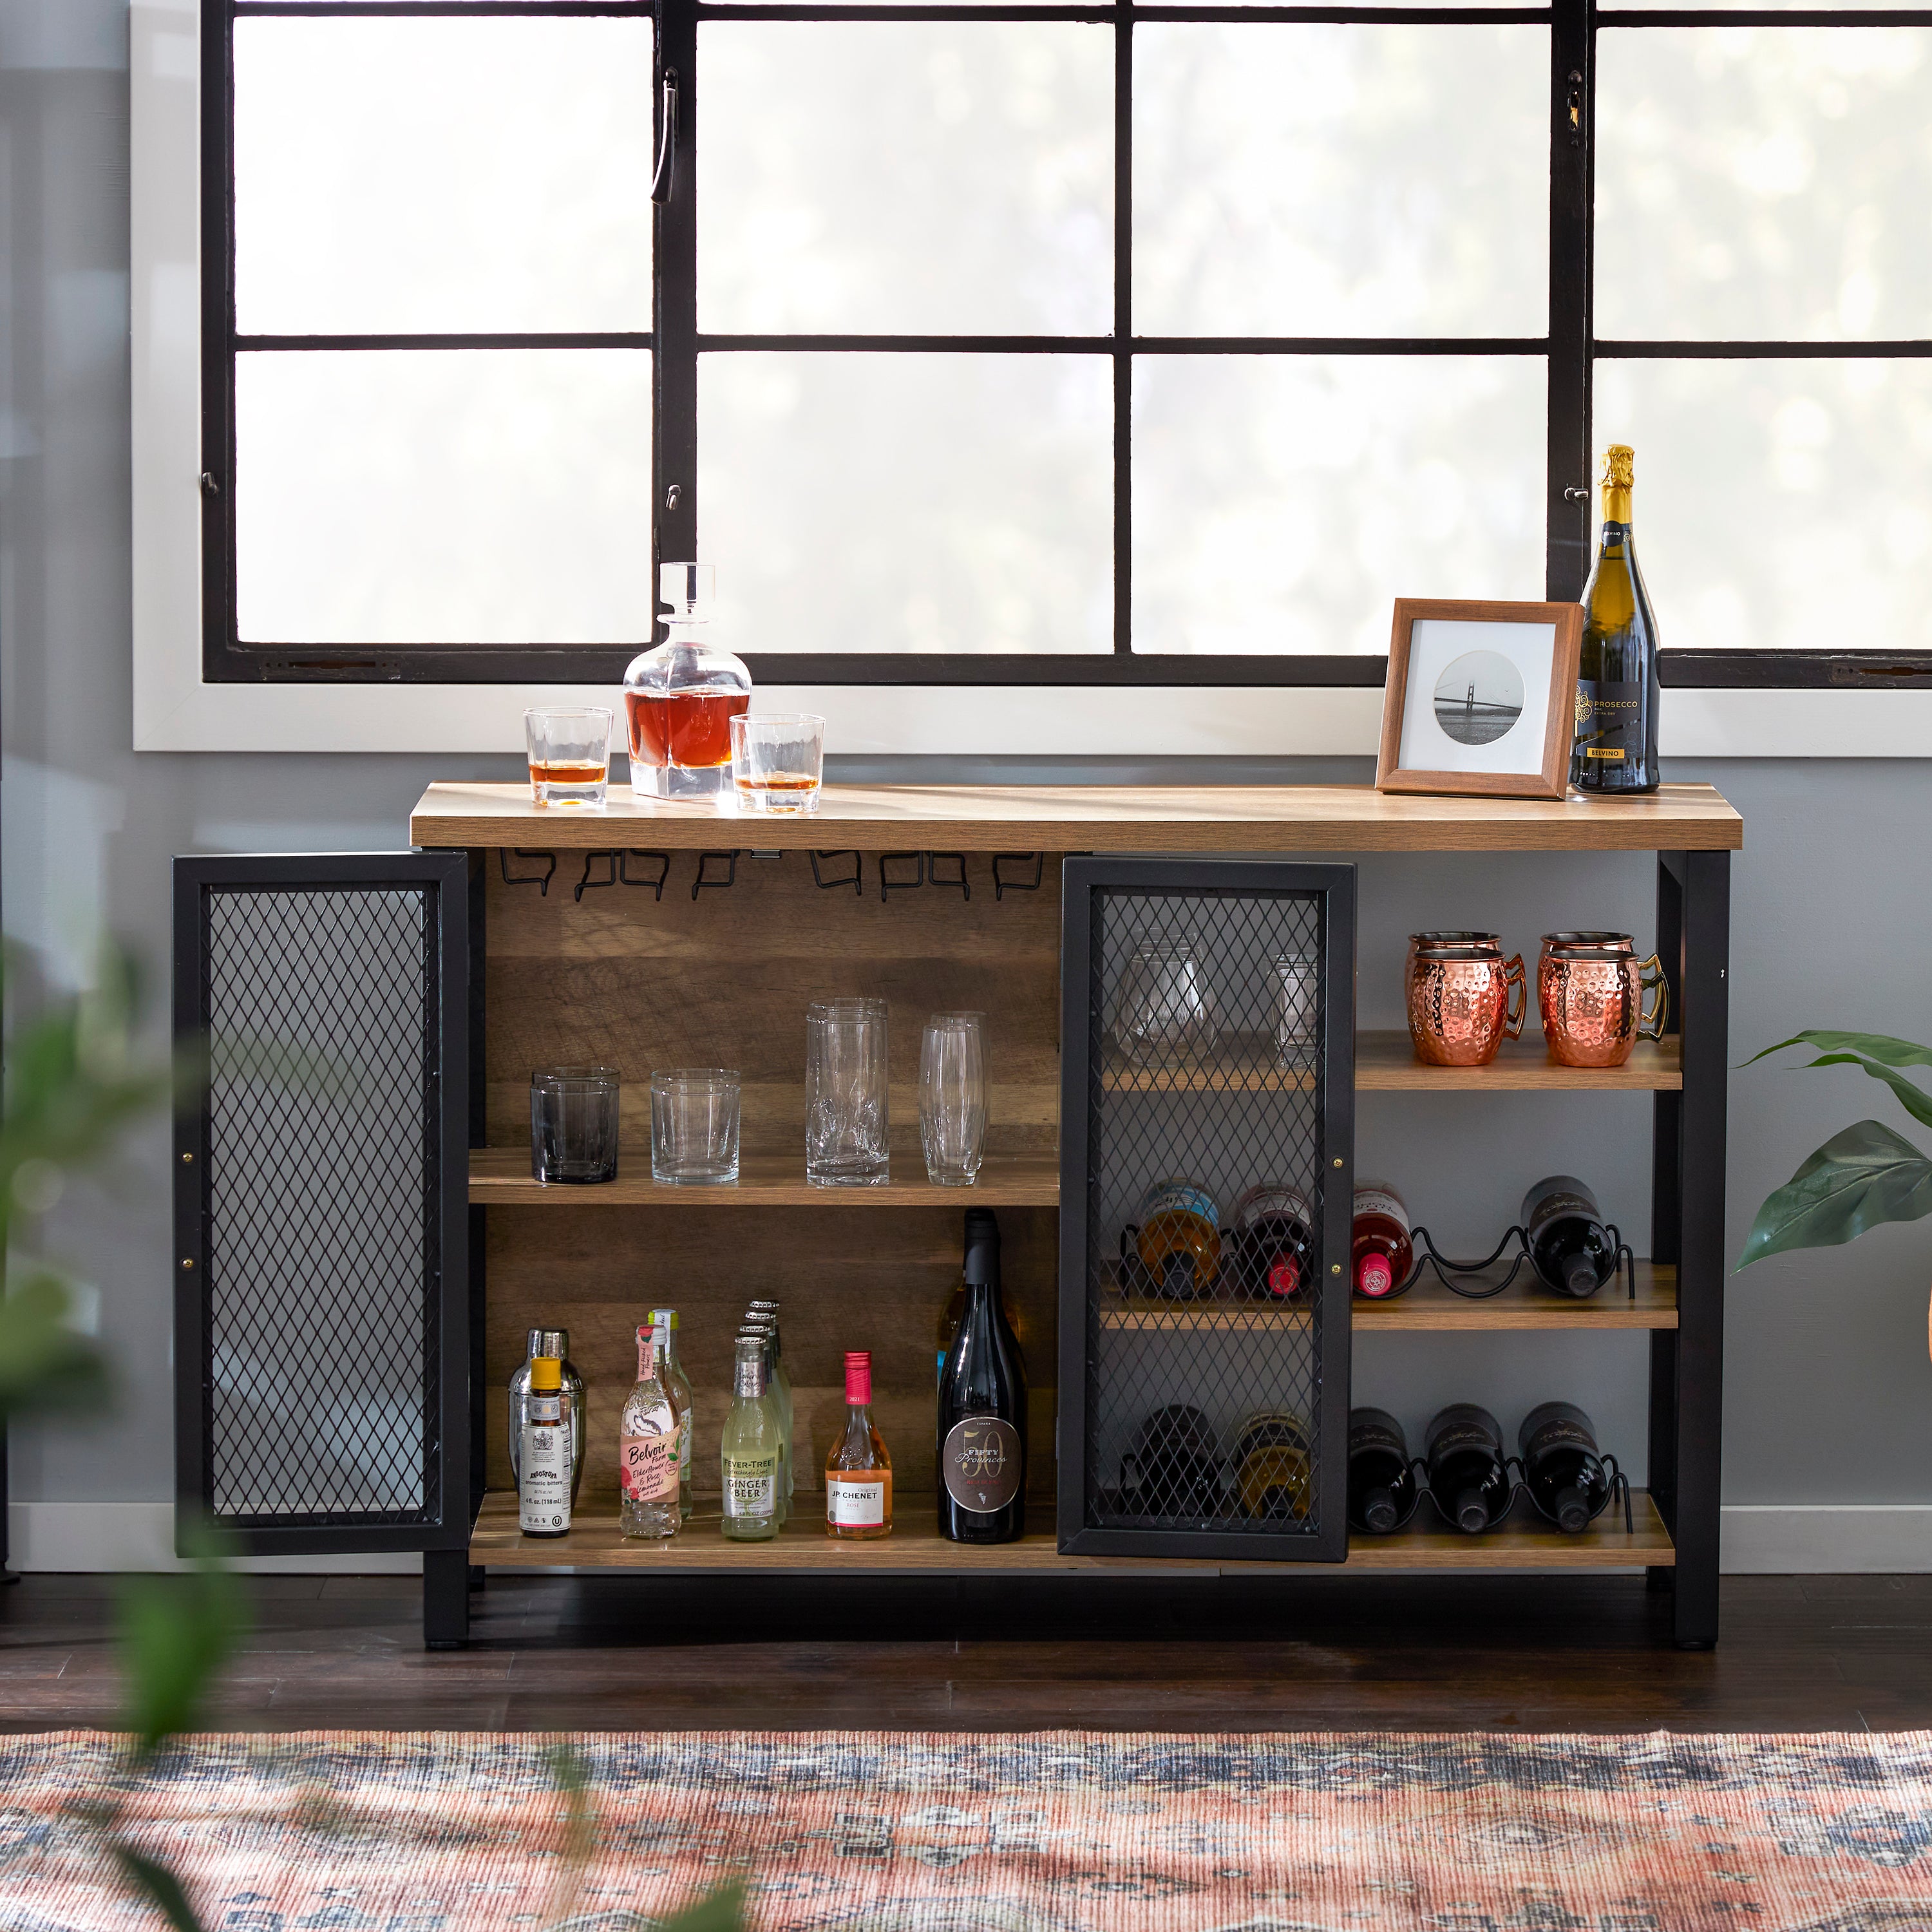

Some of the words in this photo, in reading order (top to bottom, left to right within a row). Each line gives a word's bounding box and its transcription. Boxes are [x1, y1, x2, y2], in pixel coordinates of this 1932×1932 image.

[629, 1443, 667, 1465] Belvoir
[652, 1454, 666, 1464] Farm
[954, 1453, 1007, 1463] Provinces
[962, 1430, 1003, 1478] 50
[724, 1459, 772, 1468] FEVER-TREE
[530, 1470, 557, 1479] ANGOSTURA
[632, 1462, 665, 1479] Elderflower
[639, 1477, 645, 1486] &
[646, 1473, 661, 1484] Rose
[728, 1479, 767, 1488] GINGER
[637, 1478, 664, 1493] Lemonade
[734, 1489, 761, 1497] BEER
